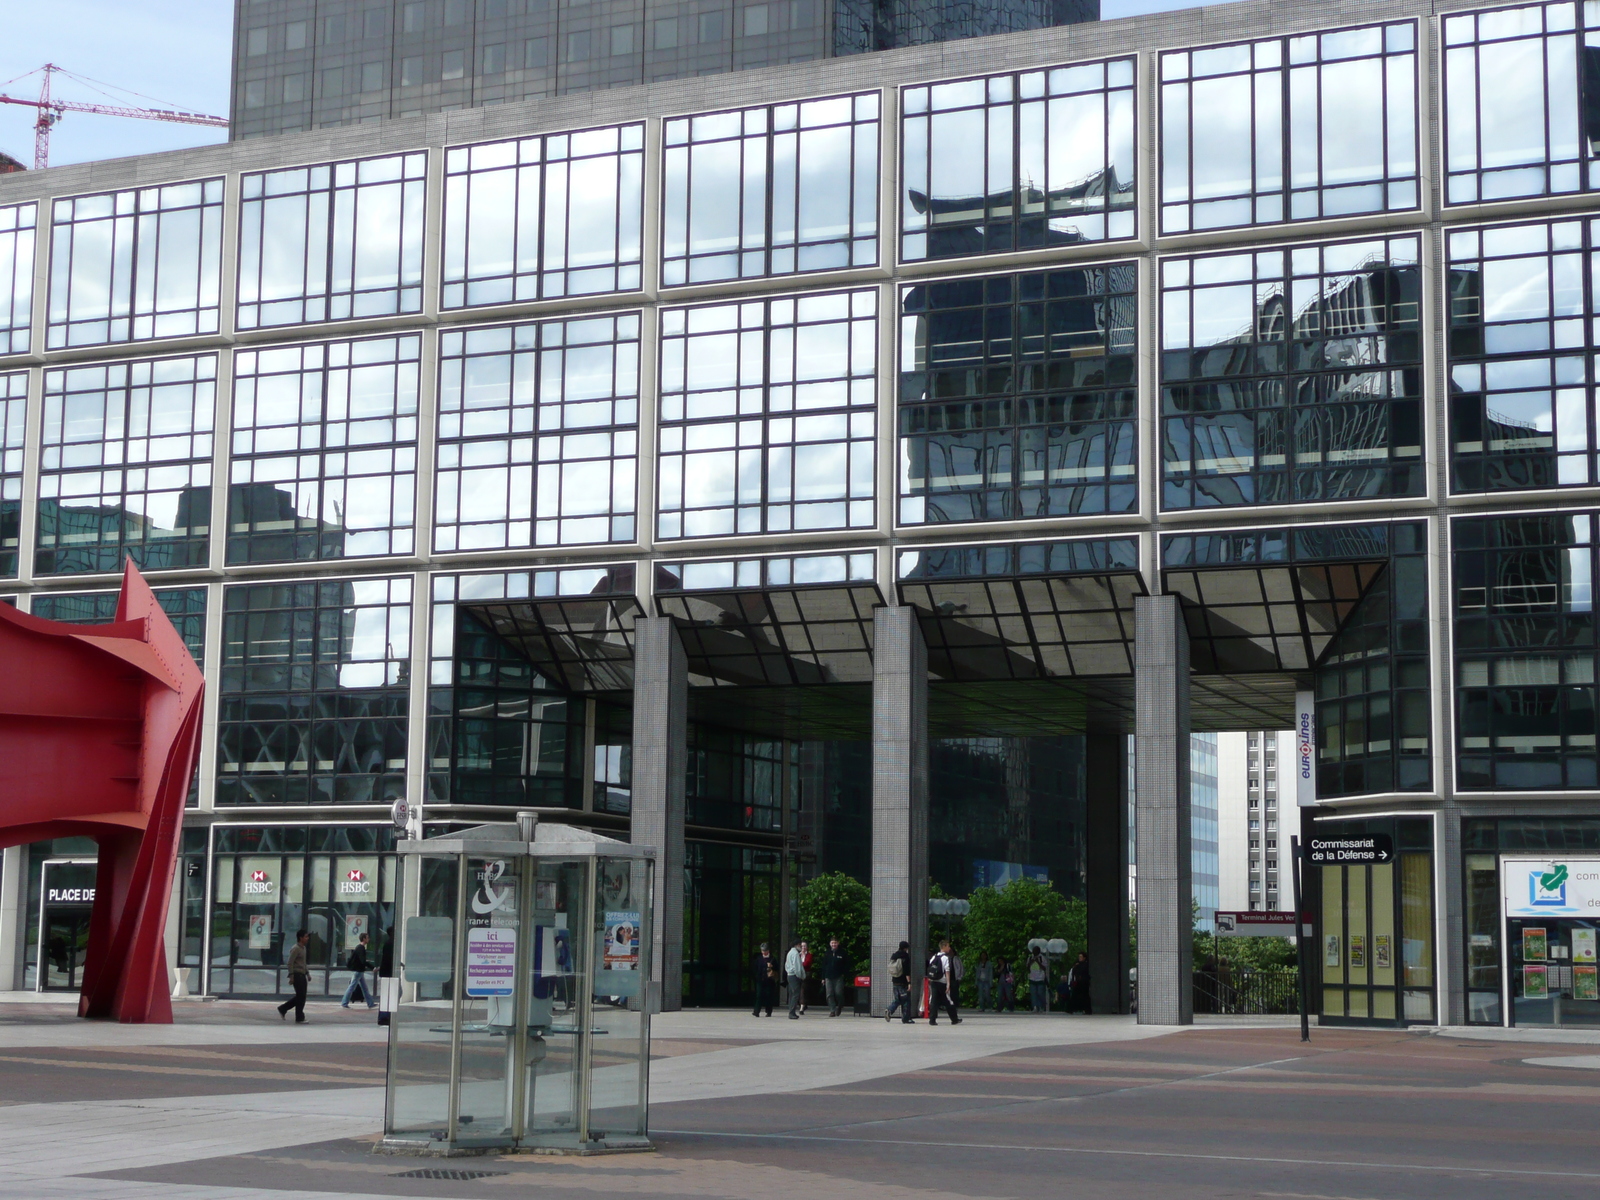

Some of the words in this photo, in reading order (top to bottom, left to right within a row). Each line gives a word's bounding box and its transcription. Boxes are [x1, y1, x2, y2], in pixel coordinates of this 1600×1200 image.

[1311, 838, 1375, 850] Commissariat
[1311, 851, 1324, 861] de
[1326, 851, 1335, 861] la
[1337, 850, 1375, 860] Défense
[244, 881, 274, 894] HSBC
[340, 881, 370, 894] HSBC
[49, 888, 82, 901] PLACE
[82, 888, 96, 901] DE
[1268, 914, 1284, 922] Jules
[486, 931, 498, 941] ici
